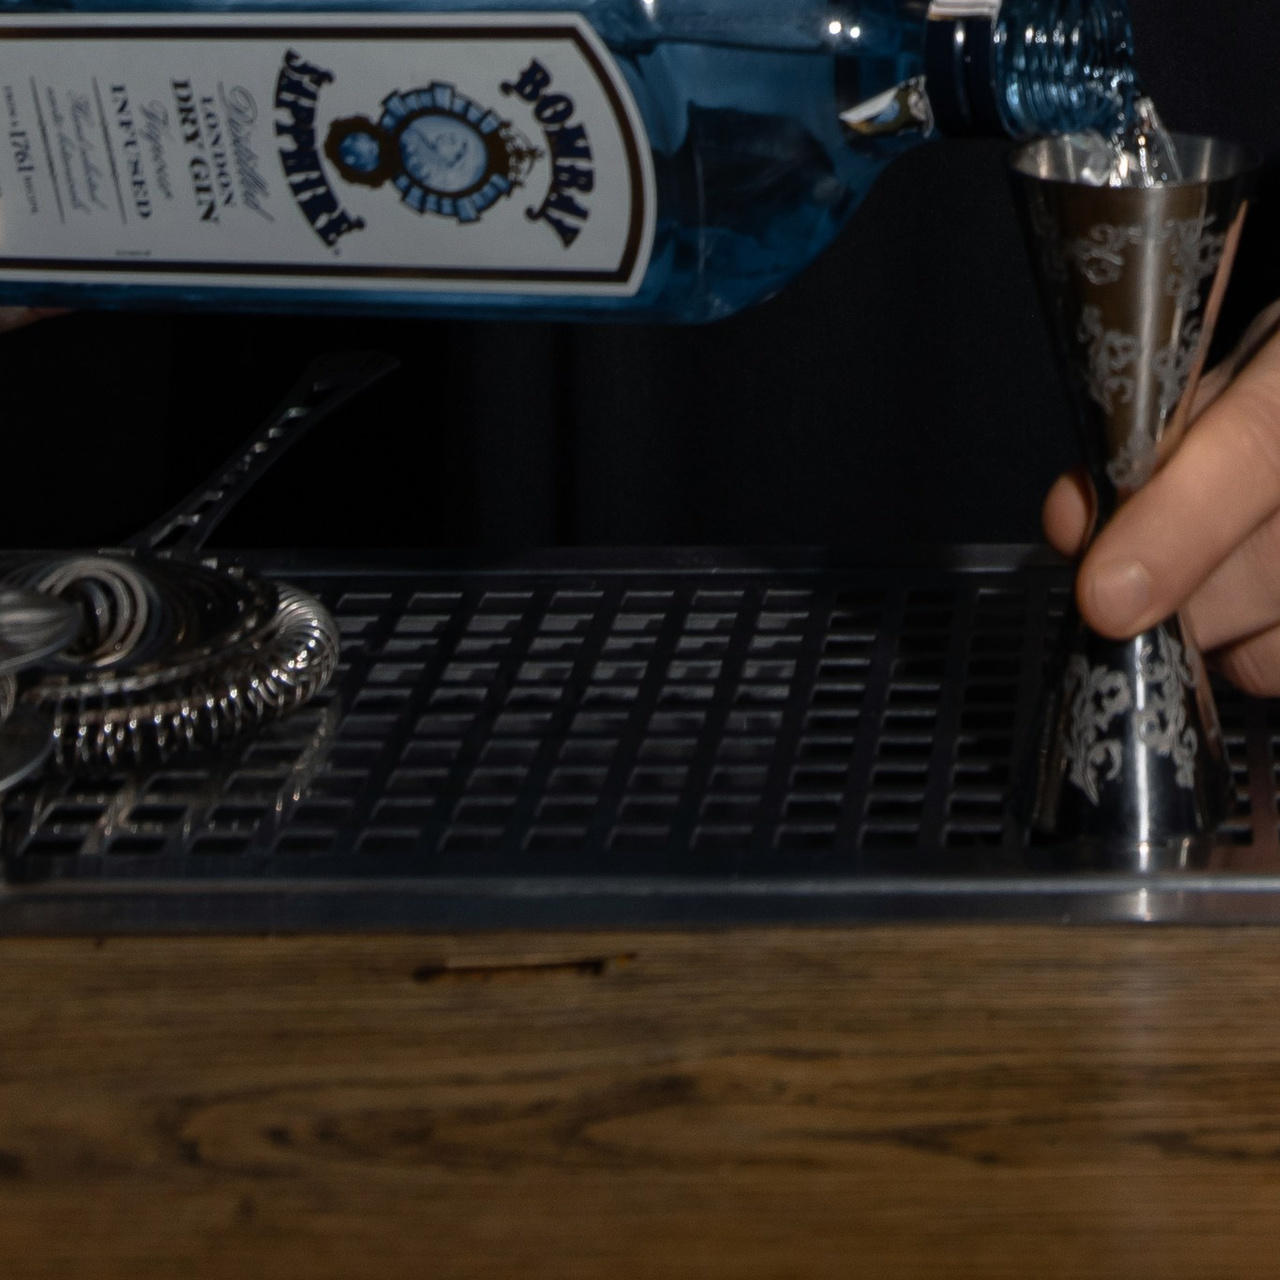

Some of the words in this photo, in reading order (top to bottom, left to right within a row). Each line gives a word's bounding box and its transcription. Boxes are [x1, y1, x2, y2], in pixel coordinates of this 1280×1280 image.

[8, 129, 36, 175] 1761
[111, 83, 154, 220] INFUSED
[172, 78, 204, 149] DRY
[188, 157, 221, 224] GIN
[201, 95, 237, 209] LONDON
[273, 46, 366, 250] SAPPHIRE
[498, 56, 596, 251] BOMBAY
